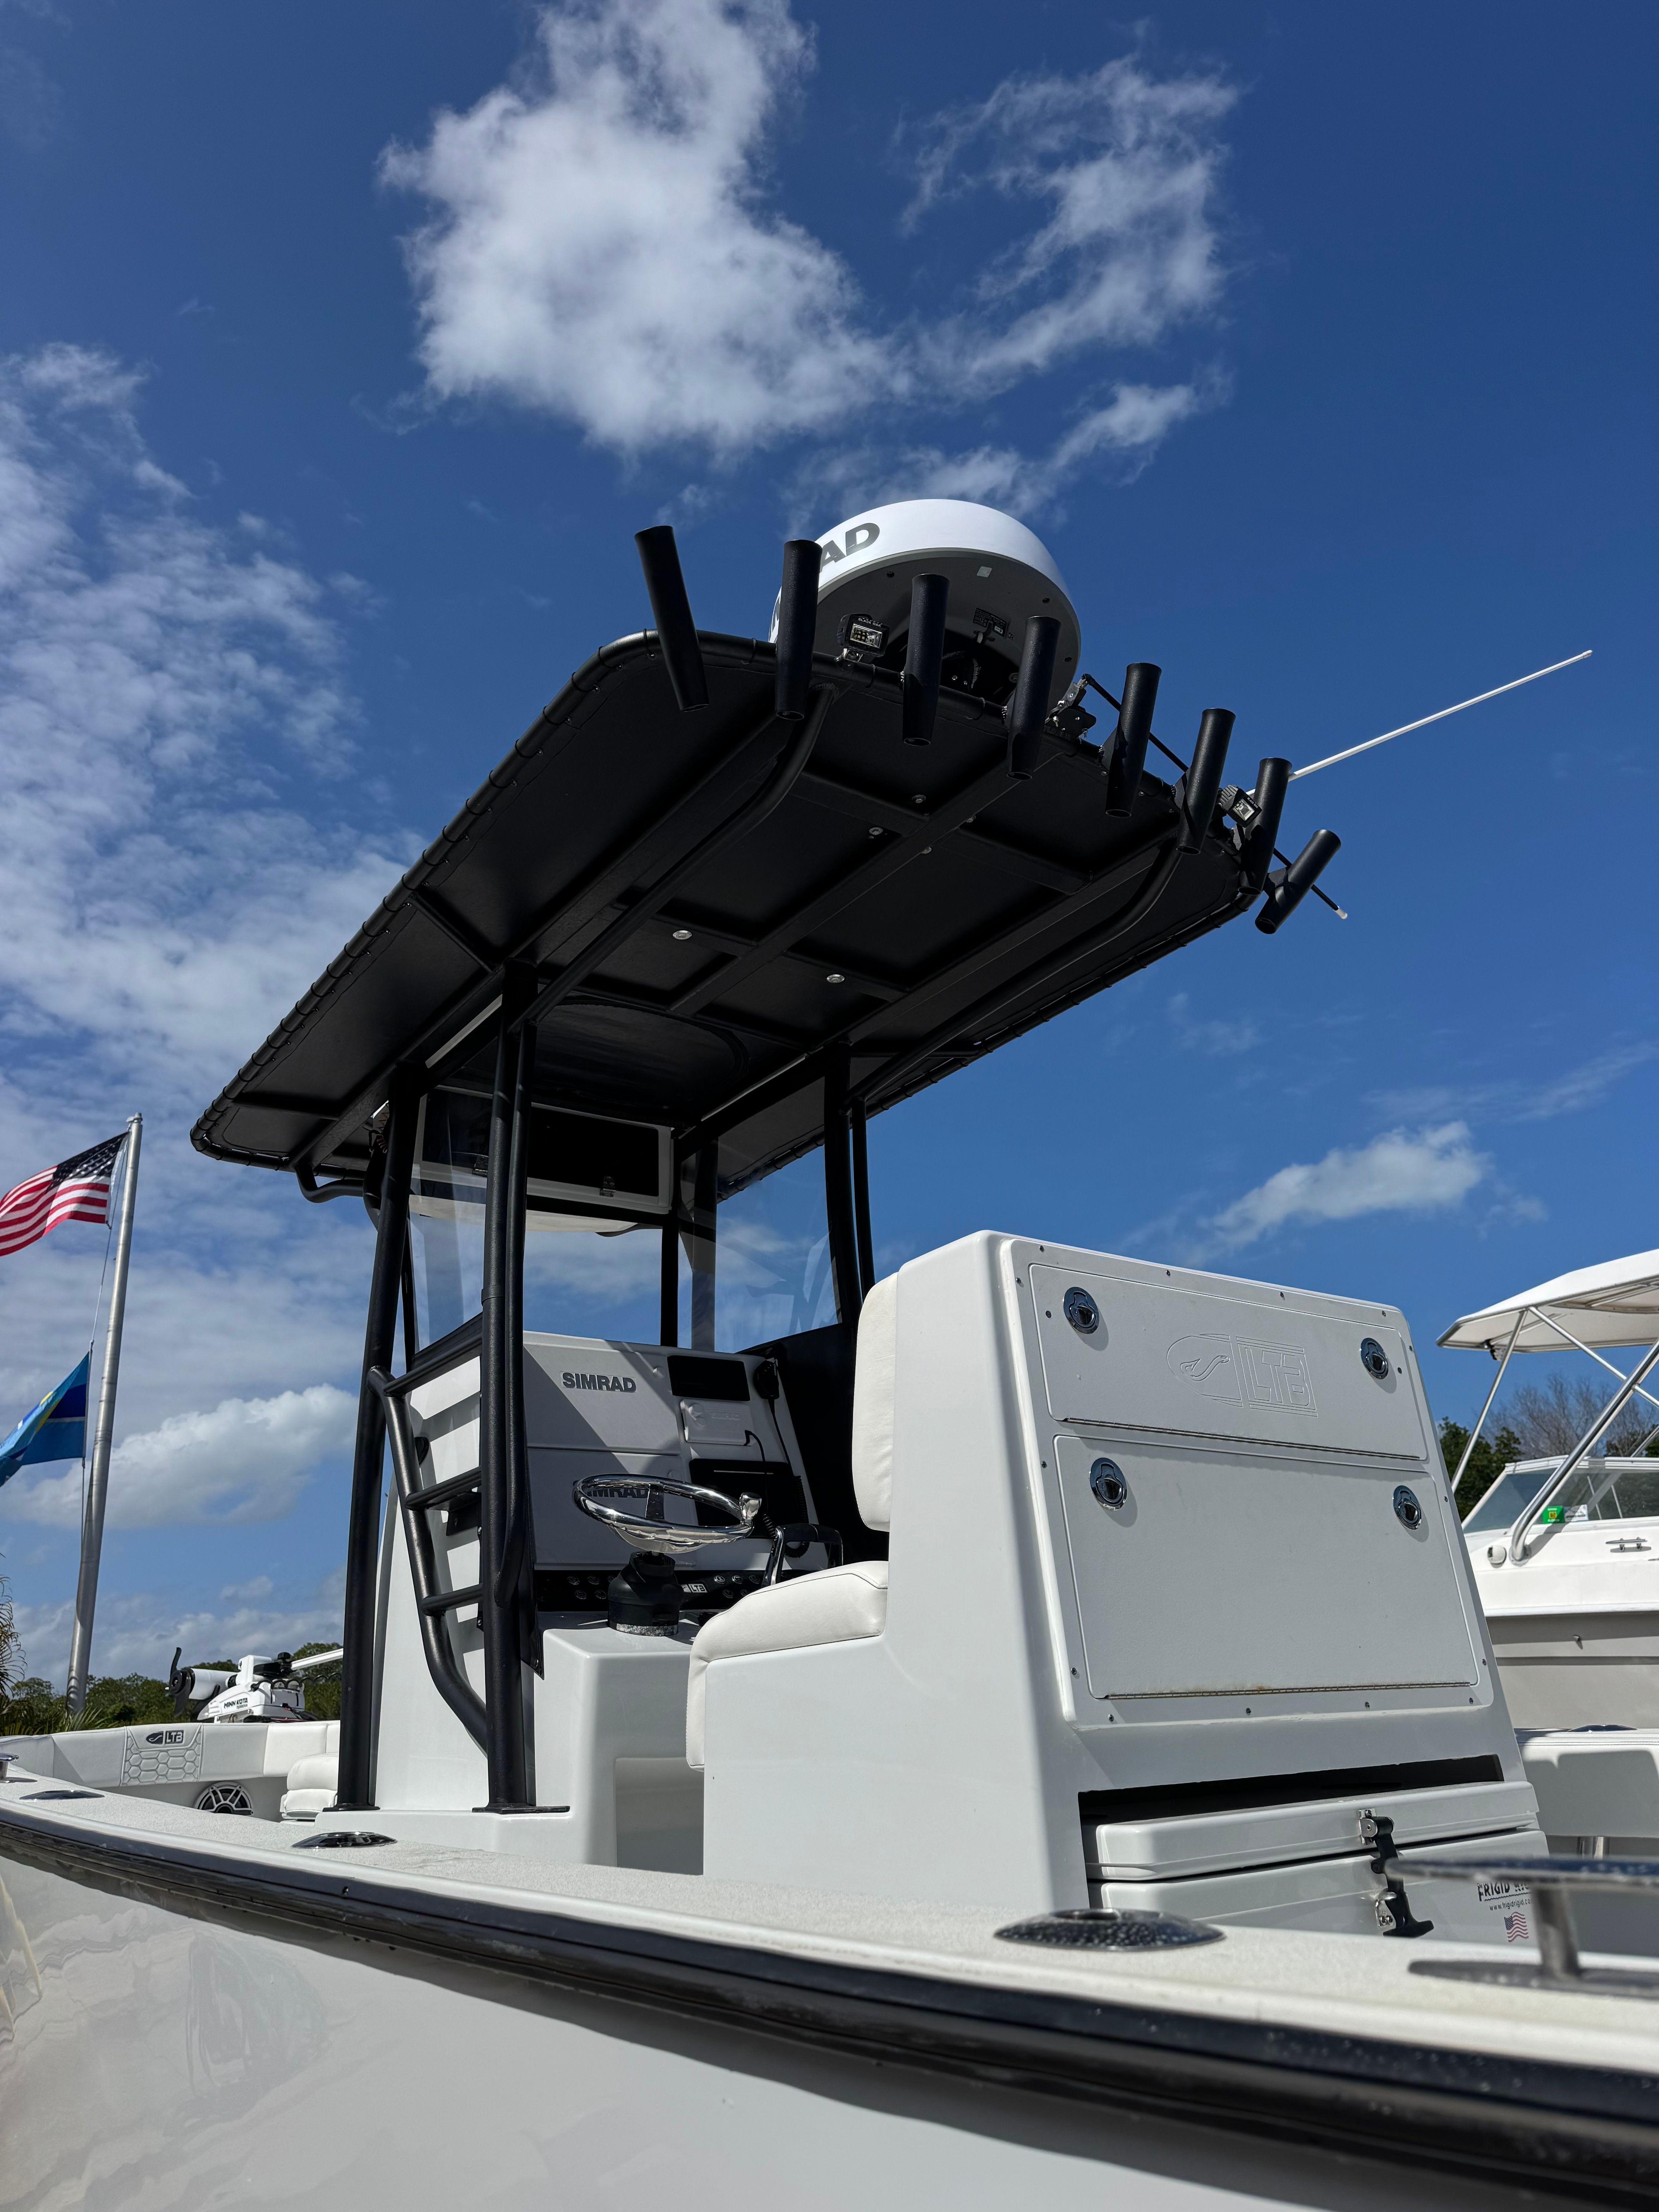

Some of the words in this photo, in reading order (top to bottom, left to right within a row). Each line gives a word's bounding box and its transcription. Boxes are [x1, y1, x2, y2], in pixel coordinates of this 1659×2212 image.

[562, 1372, 636, 1393] SIMRAD
[1245, 1347, 1310, 1406] LTB
[224, 1700, 236, 1709] MINN
[166, 1732, 183, 1742] LTB
[1477, 1882, 1510, 1901] FRIGID
[1489, 1899, 1530, 1911] www.frigidrigid.co
